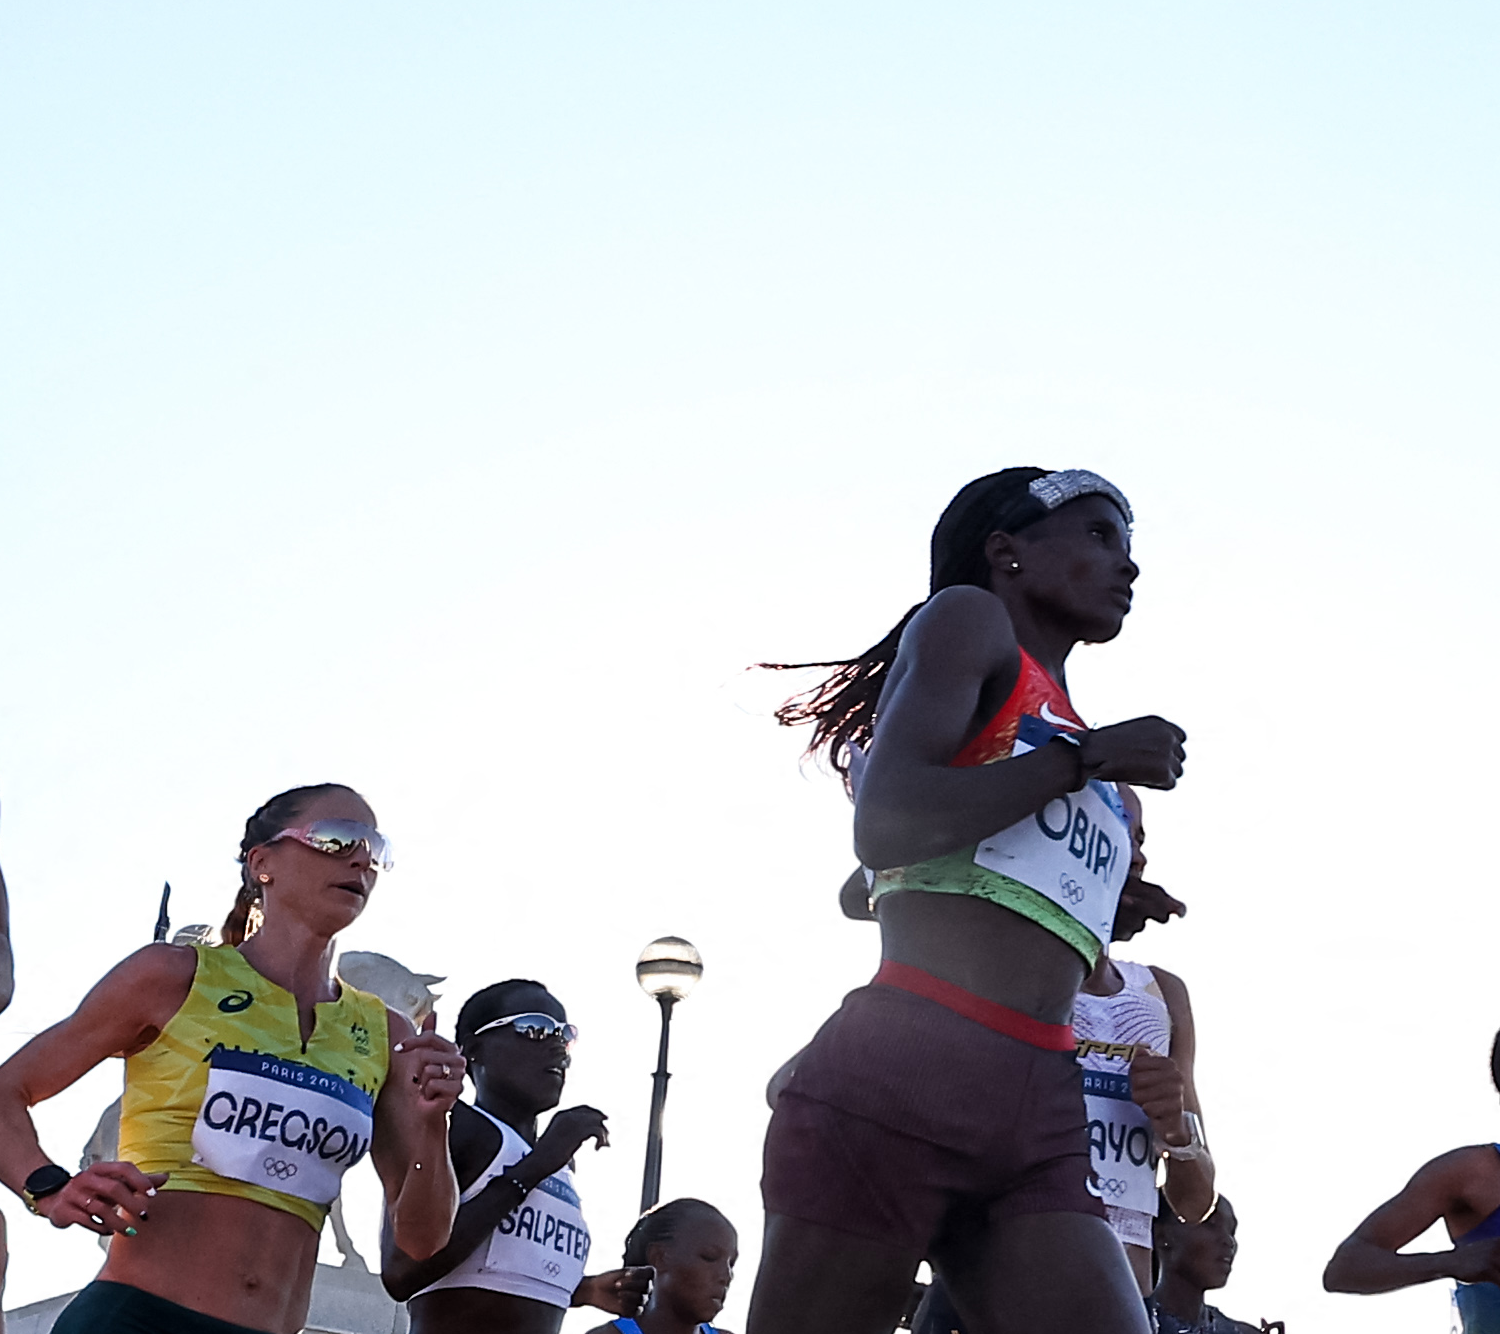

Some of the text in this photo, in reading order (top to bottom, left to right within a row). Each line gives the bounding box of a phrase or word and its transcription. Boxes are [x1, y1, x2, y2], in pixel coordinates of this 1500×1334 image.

[1035, 794, 1118, 884] OBIRI
[261, 1061, 345, 1095] PARIS 2024
[203, 1091, 368, 1167] GREGSON
[498, 1206, 592, 1262] SALPETER
